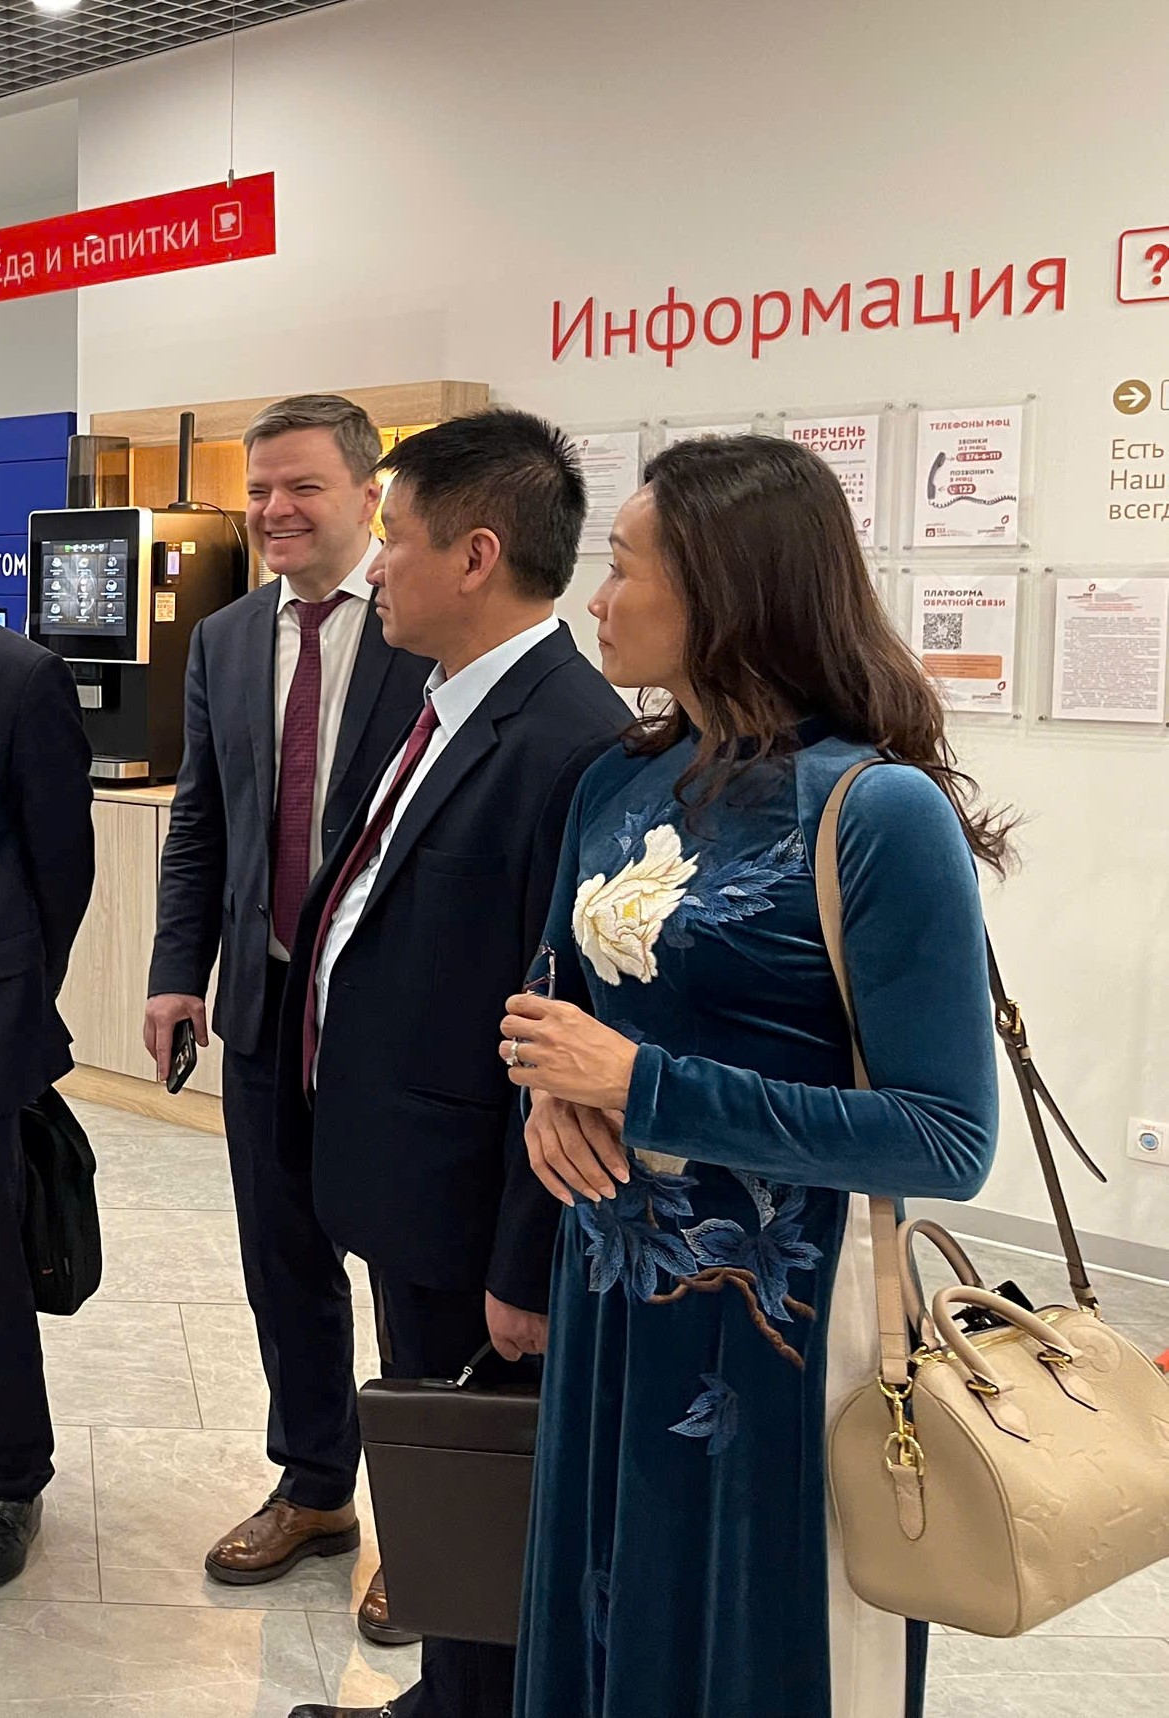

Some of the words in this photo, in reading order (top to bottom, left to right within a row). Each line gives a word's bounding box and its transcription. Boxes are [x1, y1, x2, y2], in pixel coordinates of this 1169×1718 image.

[46, 246, 62, 273] и
[73, 218, 199, 268] напитки
[552, 256, 1068, 367] Информация
[930, 420, 983, 430] ТЕЛЕФОНЫ
[986, 418, 1010, 428] МФЦ
[792, 426, 866, 441] ПЕРЕЧЕНЬ
[800, 438, 866, 453] ОСУСЛУГ
[1112, 439, 1165, 460] Есть
[1110, 469, 1166, 490] Наш
[958, 484, 973, 493] 122
[923, 589, 984, 597] ПЛАТФОРМА
[923, 598, 973, 607] ОБРАТНОЙ
[975, 599, 1006, 607] СВЯЗИ
